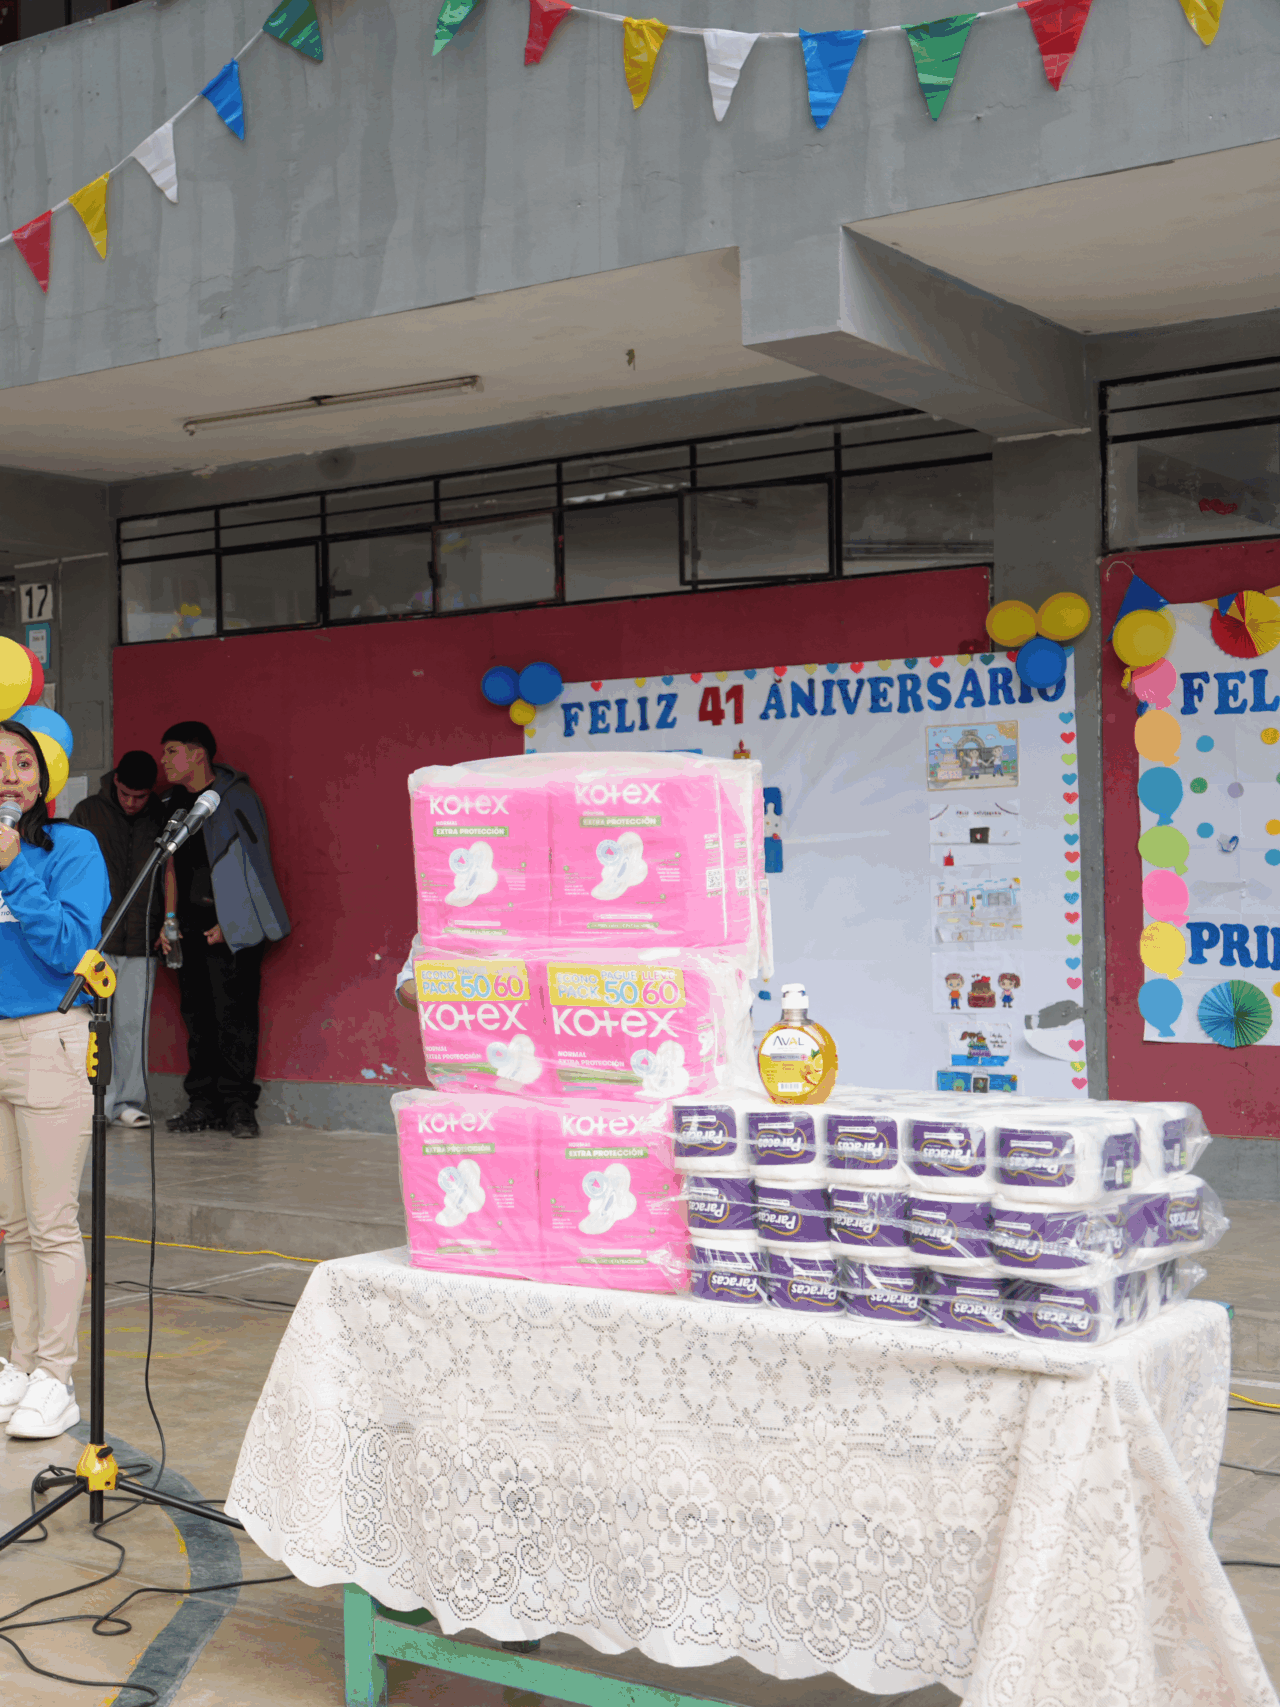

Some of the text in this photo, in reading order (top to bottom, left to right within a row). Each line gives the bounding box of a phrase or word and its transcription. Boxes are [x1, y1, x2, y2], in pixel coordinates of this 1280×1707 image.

[25, 585, 48, 619] 17
[561, 693, 678, 738] FELIZ
[698, 685, 744, 726] 41
[606, 816, 657, 826] PROTECCIÓN
[460, 826, 505, 835] PROTECCIÓN
[421, 970, 455, 980] ECONO
[556, 973, 598, 984] ECONO
[600, 970, 676, 981] PAGUE LLEVE
[422, 981, 459, 995] PACK
[460, 975, 524, 998] 50 60
[558, 985, 600, 1000] PACK
[604, 981, 680, 1006] 50 60
[557, 1051, 587, 1059] NORMAL
[568, 1147, 644, 1157] EXTRA PROTECCIÓN
[758, 1137, 802, 1152] Paracas
[837, 1141, 884, 1158] Paracas
[923, 1147, 972, 1164] Paracas
[711, 1274, 758, 1292] Paracas
[791, 1283, 838, 1300] Paracas
[870, 1292, 919, 1309] Paracas
[953, 1302, 1004, 1321] Paracas
[1036, 1309, 1090, 1330] Paracas
